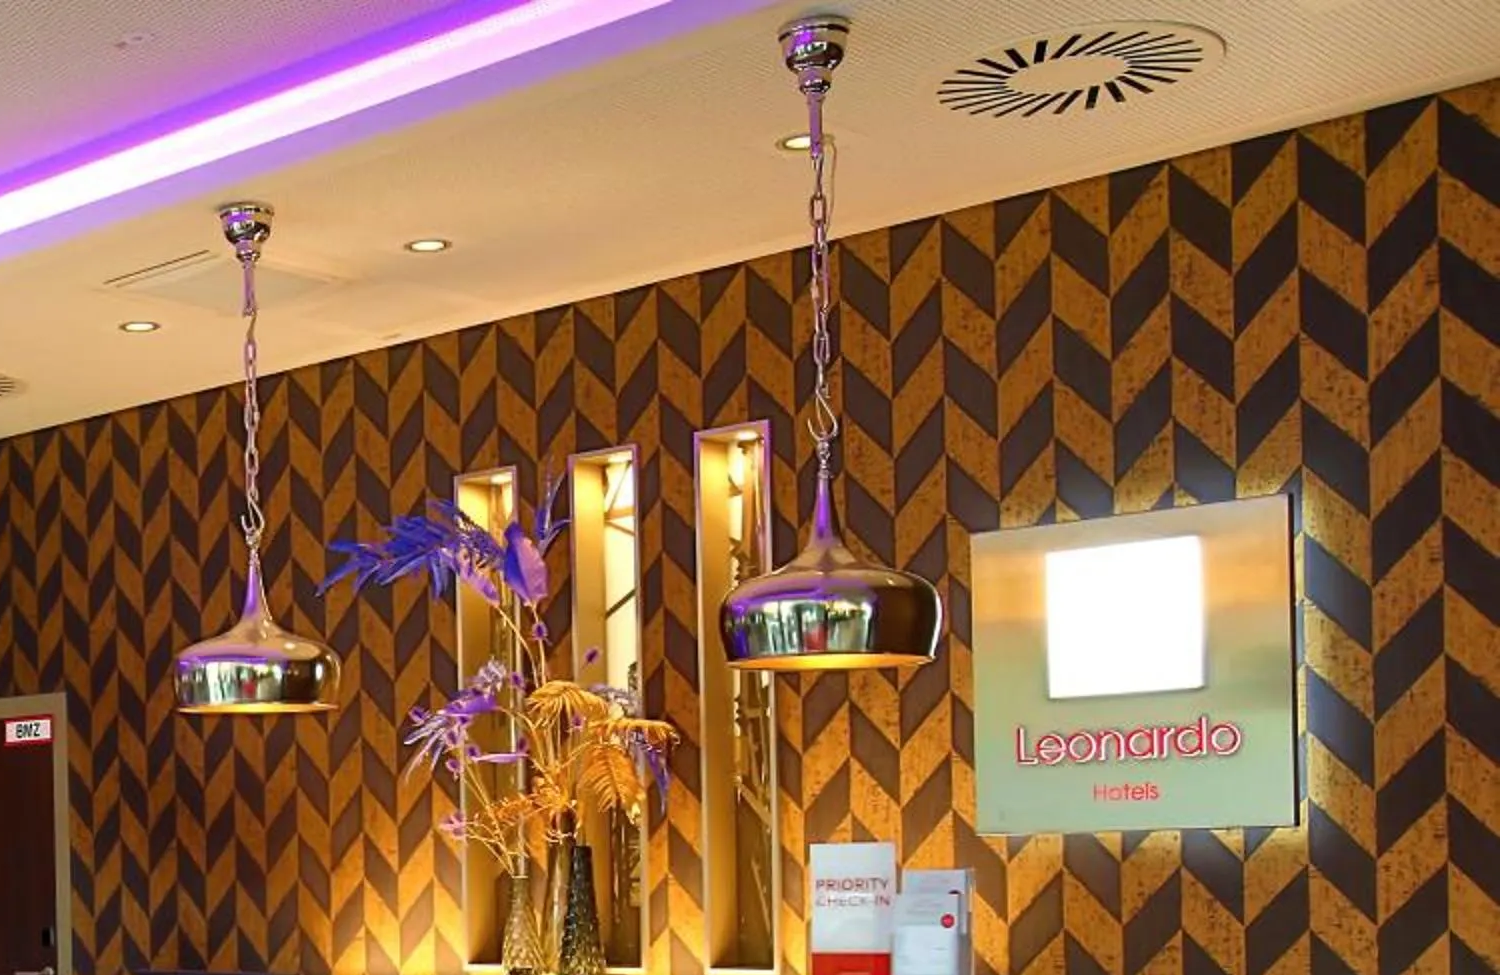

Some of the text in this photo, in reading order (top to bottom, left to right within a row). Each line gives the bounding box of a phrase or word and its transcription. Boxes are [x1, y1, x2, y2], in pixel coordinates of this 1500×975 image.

[15, 722, 41, 739] BMZ
[1014, 714, 1242, 766] Leonardo
[1092, 781, 1160, 802] Hotels
[815, 877, 890, 892] PRIORITY
[815, 895, 891, 908] CHECK-IN
